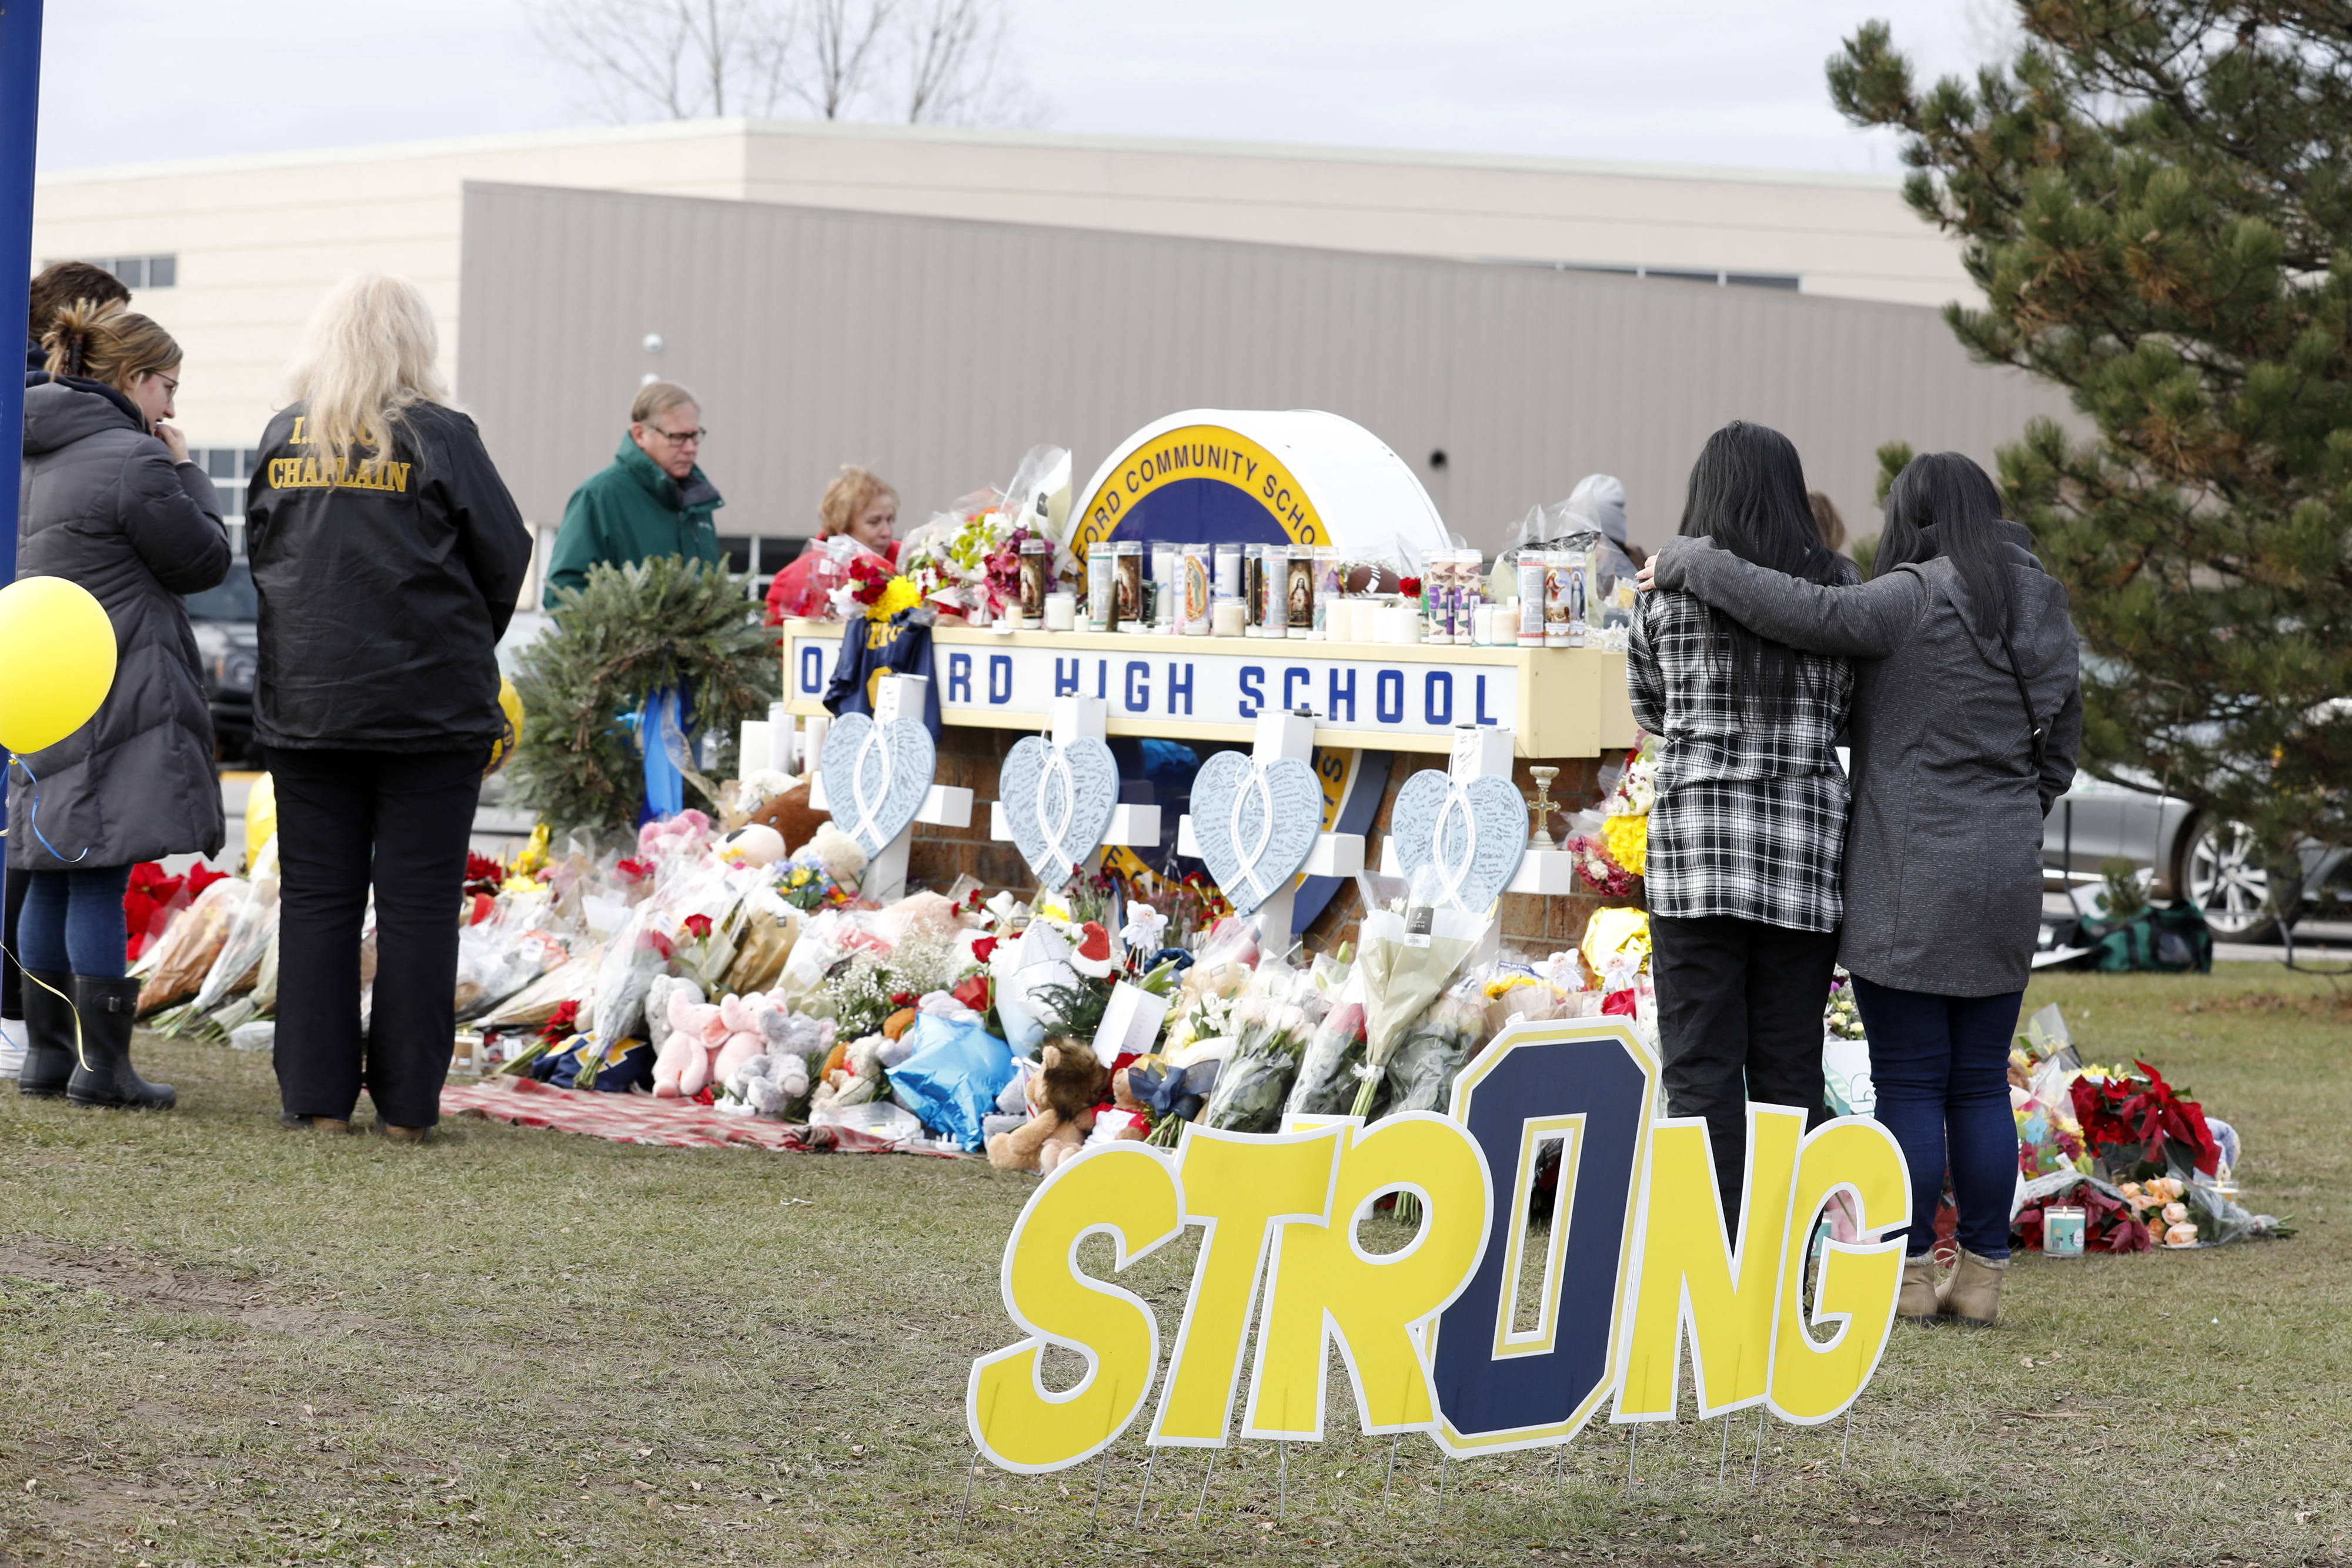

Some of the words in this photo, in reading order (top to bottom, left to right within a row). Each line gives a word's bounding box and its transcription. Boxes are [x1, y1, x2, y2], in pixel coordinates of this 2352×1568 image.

[268, 457, 411, 493] CHAPLAIN
[1125, 444, 1257, 493] COMMUNITY
[1055, 657, 1194, 715] HIGH
[1239, 666, 1498, 726] SCHOOL
[967, 1015, 1913, 1475] STRONG
